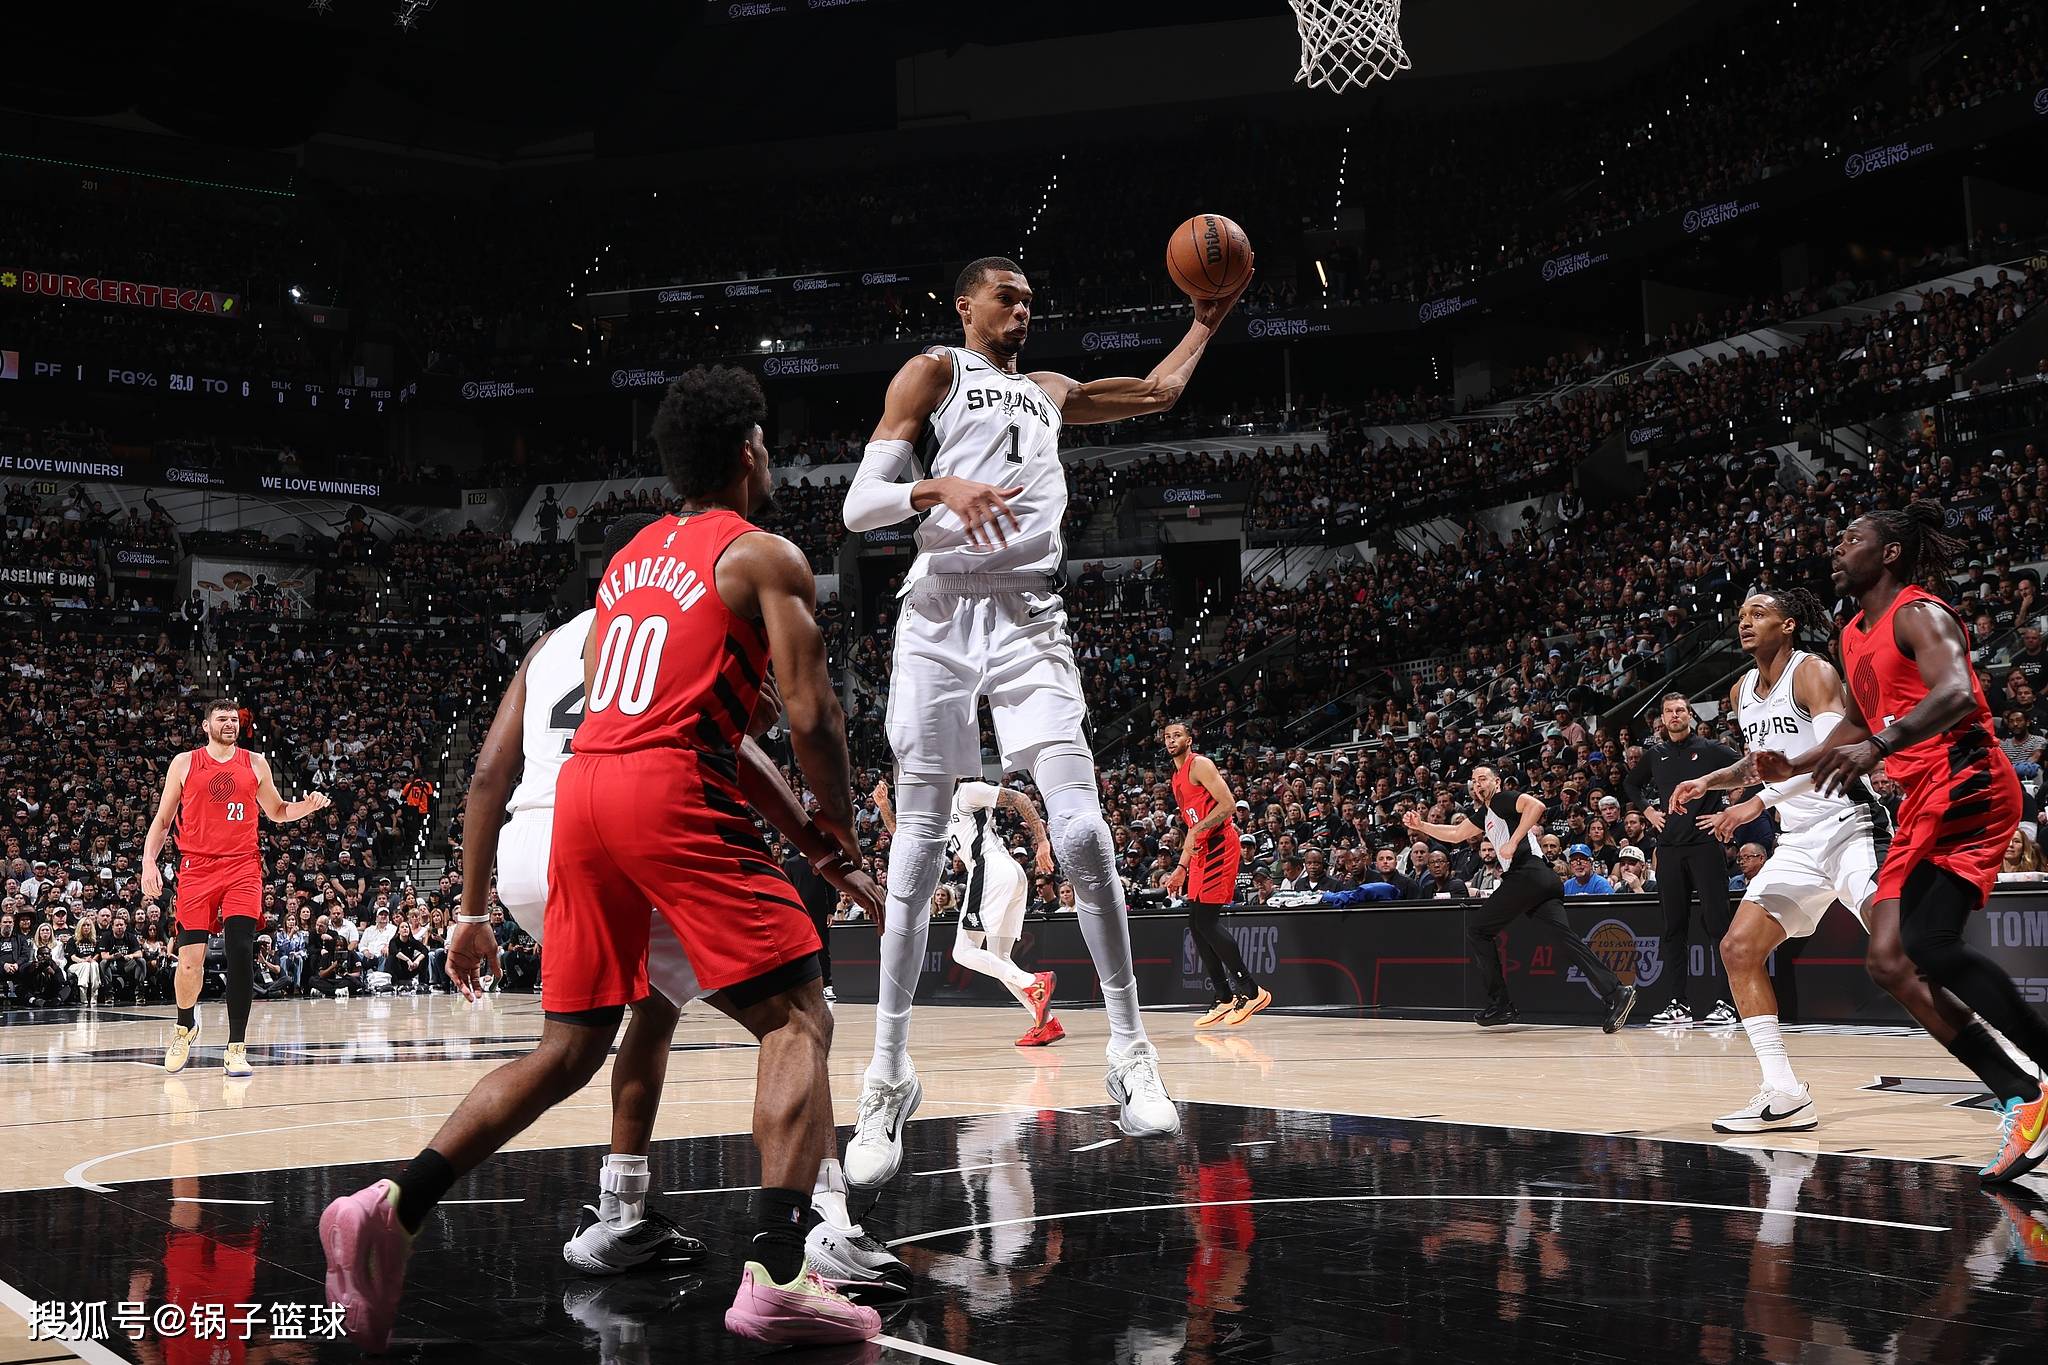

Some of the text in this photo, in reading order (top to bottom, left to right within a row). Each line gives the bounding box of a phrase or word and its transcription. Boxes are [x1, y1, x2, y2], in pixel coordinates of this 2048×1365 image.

[741, 8, 771, 16] CASINO
[1865, 148, 1886, 162] LUCKY
[1886, 142, 1910, 154] EAGLE
[1865, 143, 1936, 172] CASINO HOTEL
[81, 180, 98, 193] 201
[1701, 206, 1718, 218] LUCKY
[1719, 200, 1739, 212] EAGLE
[1701, 201, 1760, 228] CASINO HOTEL
[1204, 215, 1221, 265] Wilson
[1557, 258, 1591, 276] CASINO
[2025, 255, 2048, 272] 06
[22, 270, 217, 314] BURGERTECA
[1432, 302, 1462, 319] CASINO
[1267, 323, 1331, 336] CASINO HOTEL
[1100, 334, 1120, 342] LUCKY
[1100, 336, 1162, 350] CASINO HOTEL
[781, 363, 840, 374] CASINO HOTEL
[34, 361, 251, 397] PF 1 FG% 25.0 TO 6
[271, 379, 291, 390] BLK
[629, 376, 665, 386] CASINO
[1614, 372, 1631, 386] 105
[304, 383, 325, 394] STL
[336, 388, 358, 397] AST
[370, 390, 391, 399] REB
[480, 387, 535, 398] CASINO HOTEL
[278, 391, 284, 404] 0
[311, 395, 318, 407] 0
[344, 399, 351, 410] 2
[377, 401, 384, 413] 2
[967, 388, 1050, 428] SPURS
[1006, 424, 1023, 464] 1
[16, 457, 53, 472] LOVE
[55, 460, 124, 478] WINNERS!
[180, 476, 209, 484] CASINO
[261, 476, 380, 497] WE LOVE WINNERS!
[36, 482, 56, 495] 101
[470, 493, 486, 504] 102
[1177, 493, 1206, 502] CASINO
[0, 568, 95, 588] ASELINE BUMS
[598, 555, 708, 613] HENDERSON
[589, 613, 670, 717] 00
[1742, 716, 1799, 747] SPURS
[226, 802, 245, 821] 23
[1599, 940, 1657, 949] LOS ANGELES
